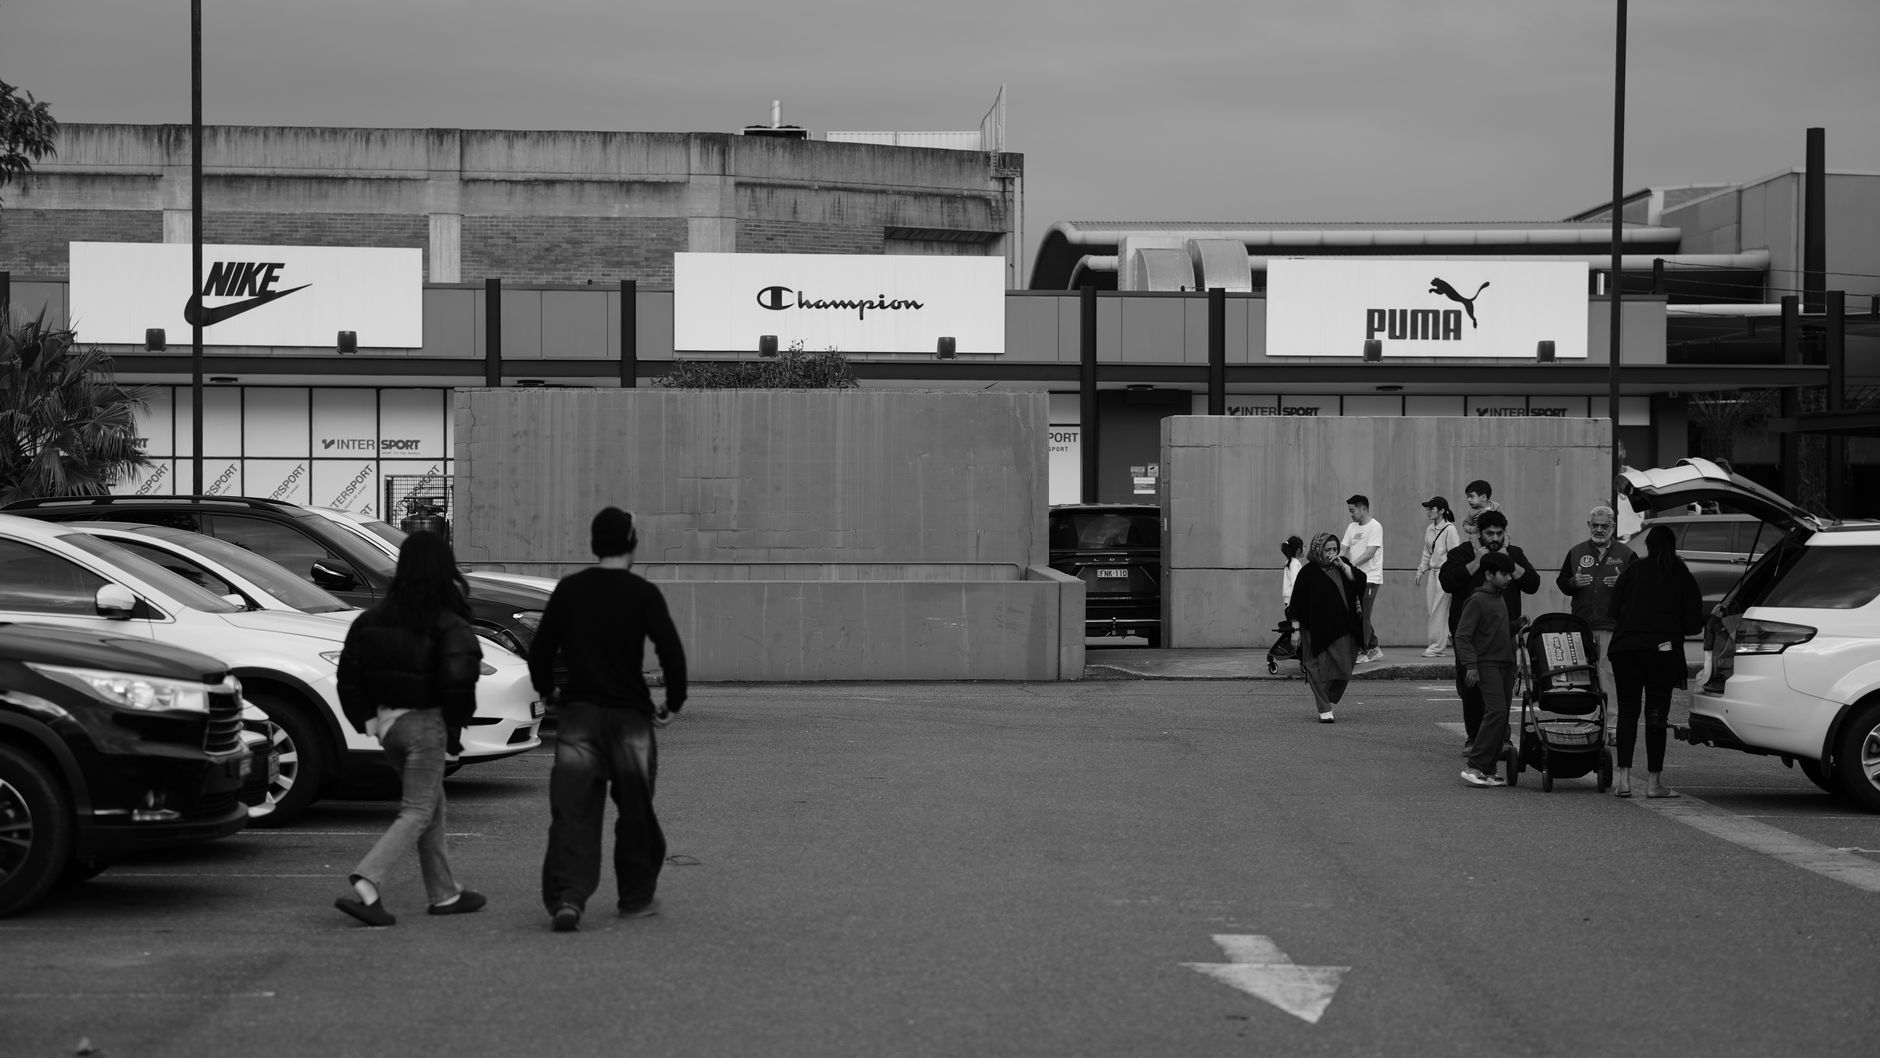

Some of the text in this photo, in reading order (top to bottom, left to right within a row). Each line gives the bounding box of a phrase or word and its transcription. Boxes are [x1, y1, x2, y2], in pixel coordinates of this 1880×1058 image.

[202, 261, 286, 297] NIKE
[756, 285, 924, 320] Champion
[1366, 308, 1462, 341] PUMA
[336, 439, 421, 450] INTER SPORT
[1049, 432, 1079, 443] PORT
[329, 464, 373, 509] TERSPORT
